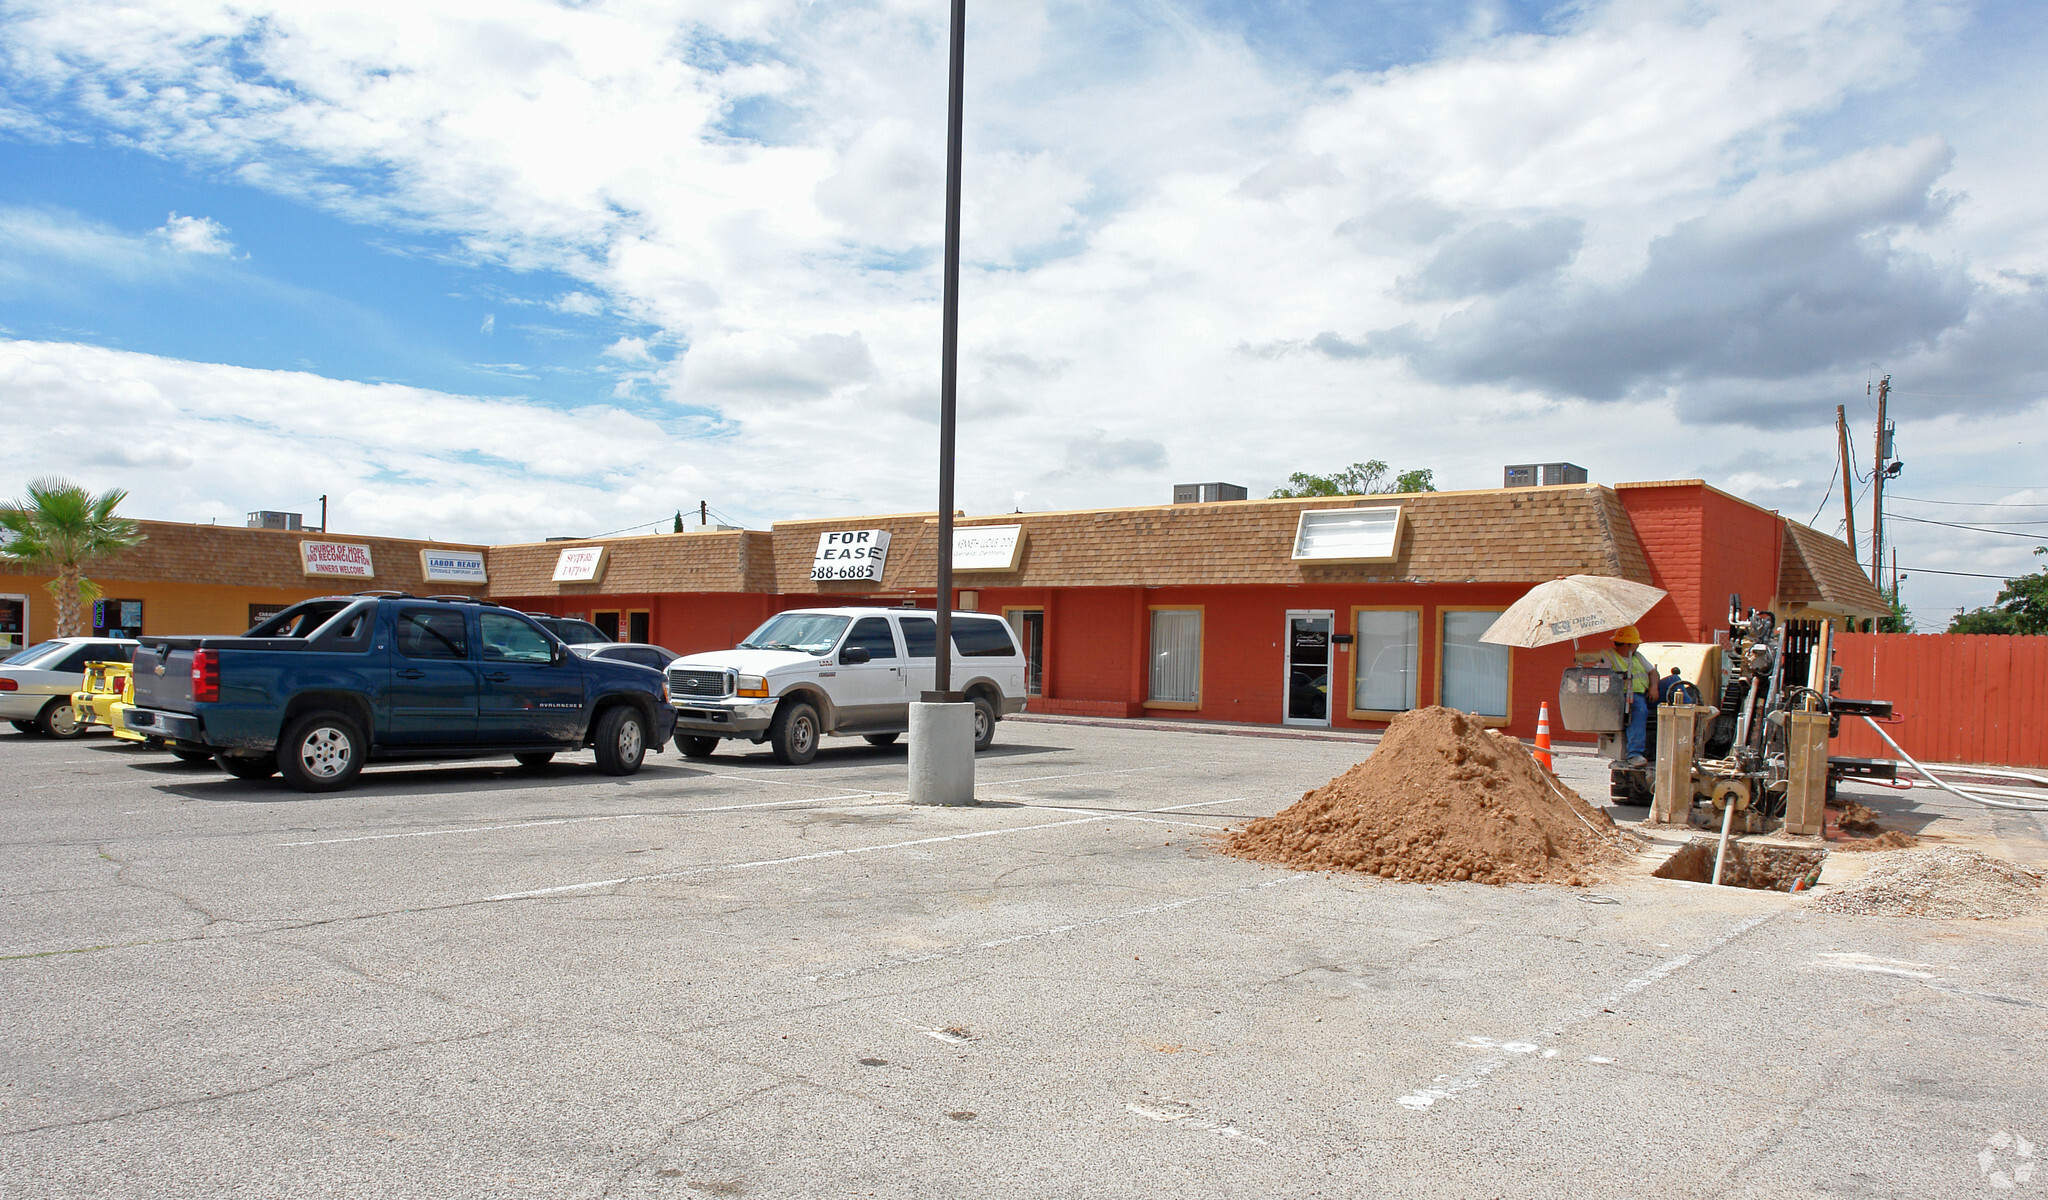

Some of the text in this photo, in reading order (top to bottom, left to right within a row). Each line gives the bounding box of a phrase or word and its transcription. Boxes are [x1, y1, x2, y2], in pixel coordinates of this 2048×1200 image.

[828, 532, 870, 545] FOR
[309, 545, 364, 556] CHURCH OF HOPE
[307, 553, 371, 567] AND RECONCILIATION
[315, 564, 365, 575] SINNERS WELCOME
[562, 566, 591, 577] TATTOO
[810, 565, 874, 579] 588-6885
[1573, 614, 1597, 625] Ditch
[1581, 619, 1606, 629] Witch
